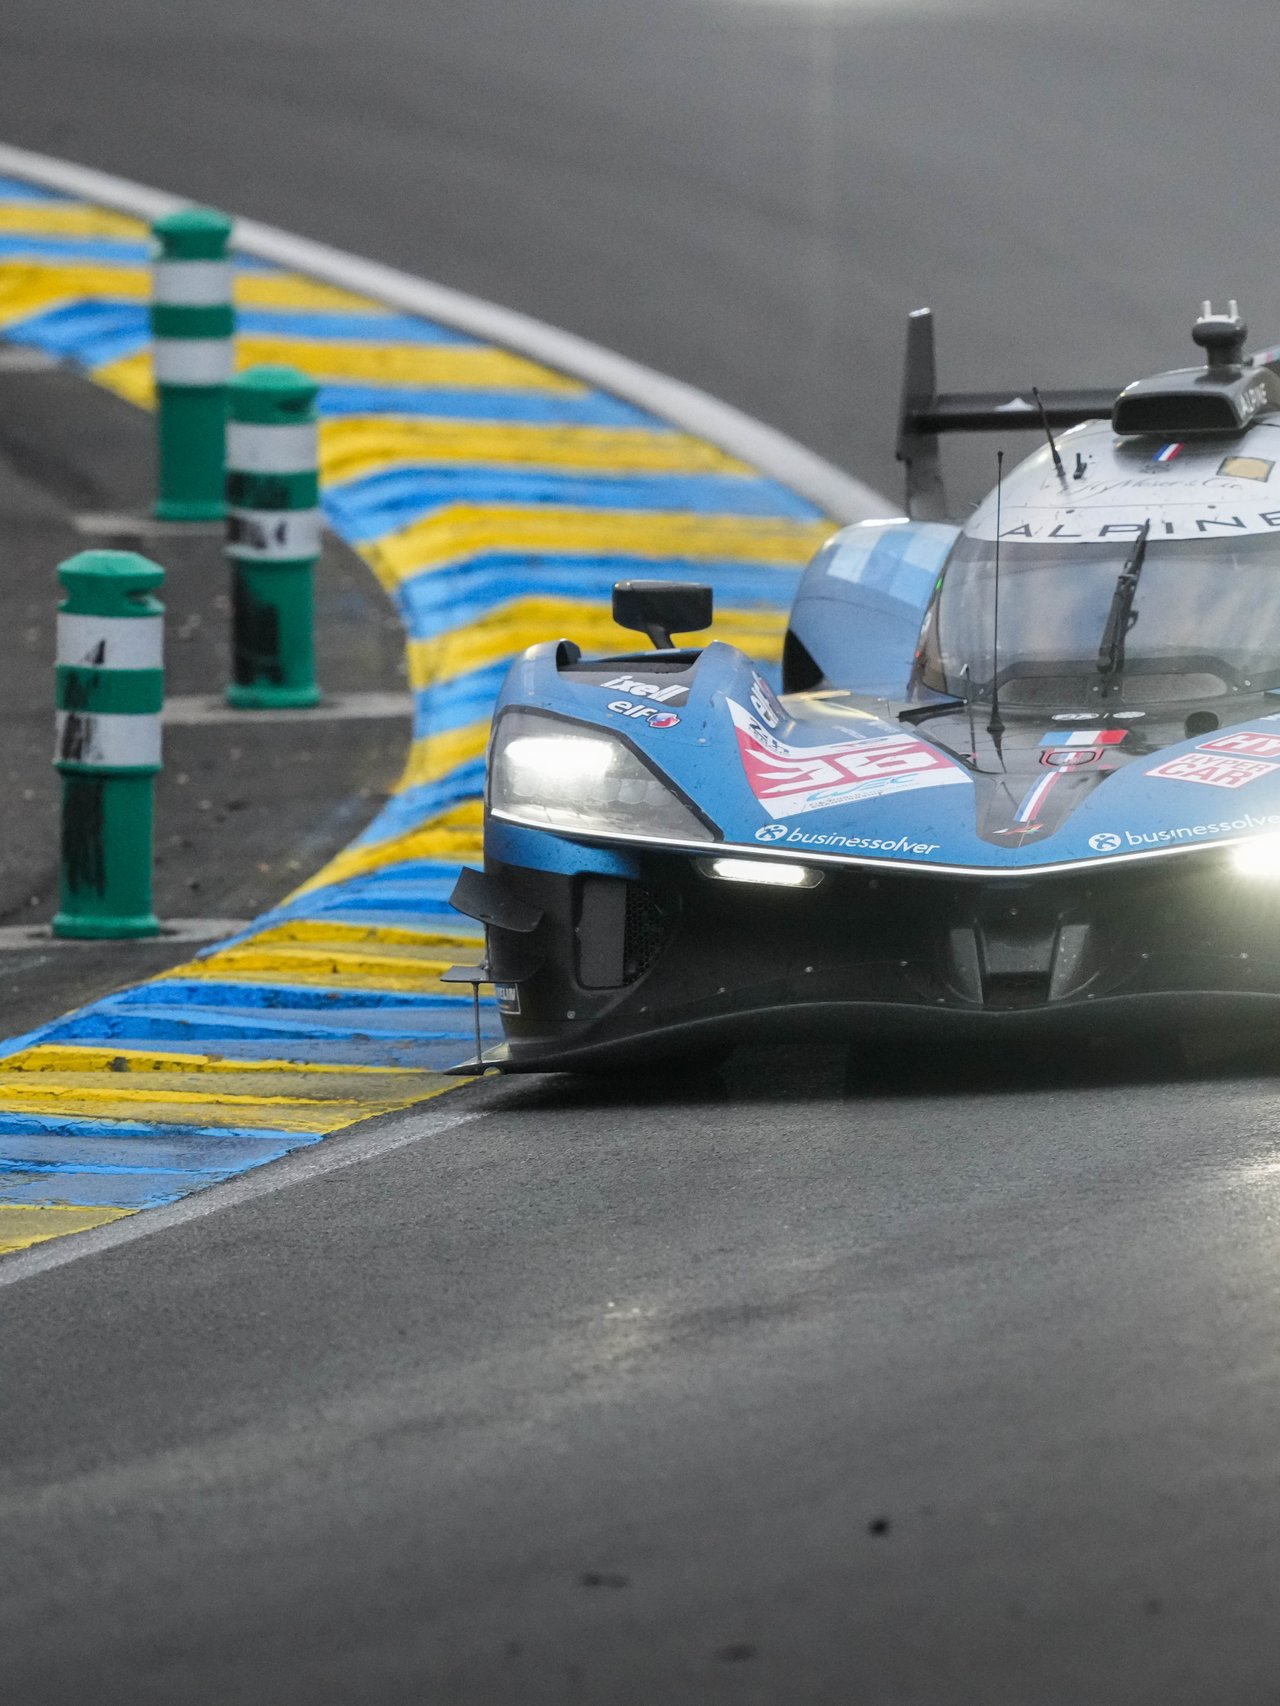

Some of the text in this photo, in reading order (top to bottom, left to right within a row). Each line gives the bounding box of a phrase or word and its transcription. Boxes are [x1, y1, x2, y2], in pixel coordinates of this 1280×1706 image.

[600, 675, 690, 703] ixell
[607, 700, 660, 720] elf
[745, 742, 939, 794] 36
[1158, 762, 1254, 786] CAR
[1180, 754, 1270, 773] HYPER
[786, 827, 941, 855] businessolver
